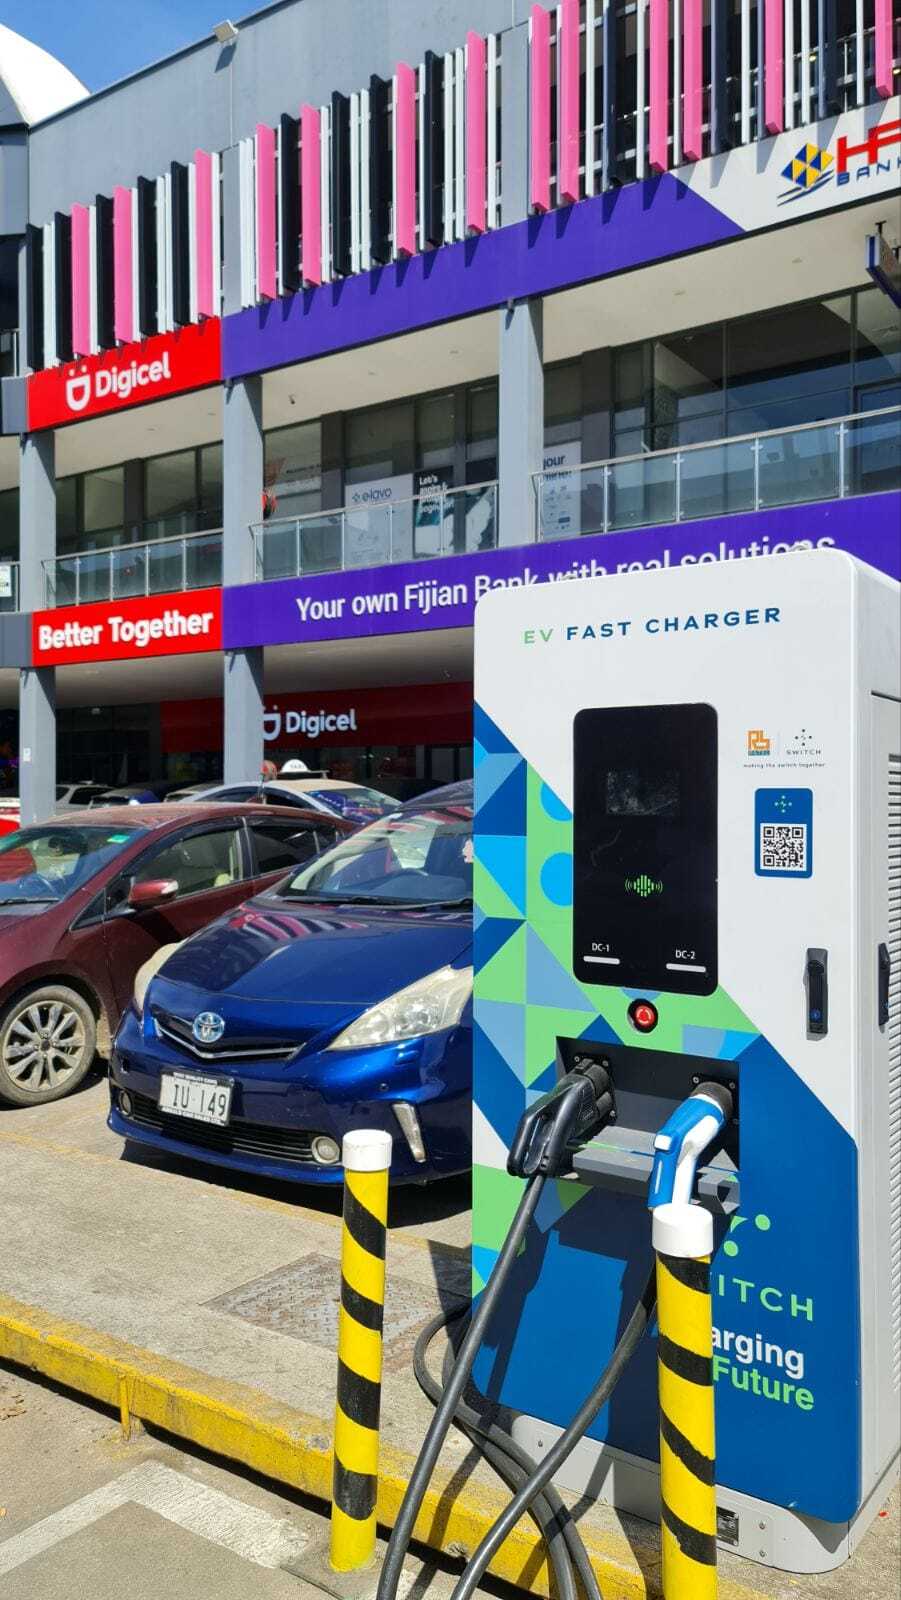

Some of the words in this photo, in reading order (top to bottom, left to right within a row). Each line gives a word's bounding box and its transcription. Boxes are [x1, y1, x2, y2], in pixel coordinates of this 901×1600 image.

[95, 352, 172, 398] Digicel
[296, 597, 346, 621] Your
[352, 592, 398, 615] own
[404, 580, 467, 614] Fijian
[39, 622, 103, 650] Better
[108, 611, 214, 647] Together
[524, 628, 554, 645] EV
[566, 621, 632, 641] FAST
[645, 607, 782, 634] CHARGER
[285, 708, 357, 738] Digicel
[591, 942, 611, 953] DC-1
[674, 949, 696, 960] DC-2
[200, 1089, 227, 1116] 149
[718, 1273, 814, 1322] ITCH
[712, 1326, 805, 1380] arging
[712, 1354, 815, 1411] Future
